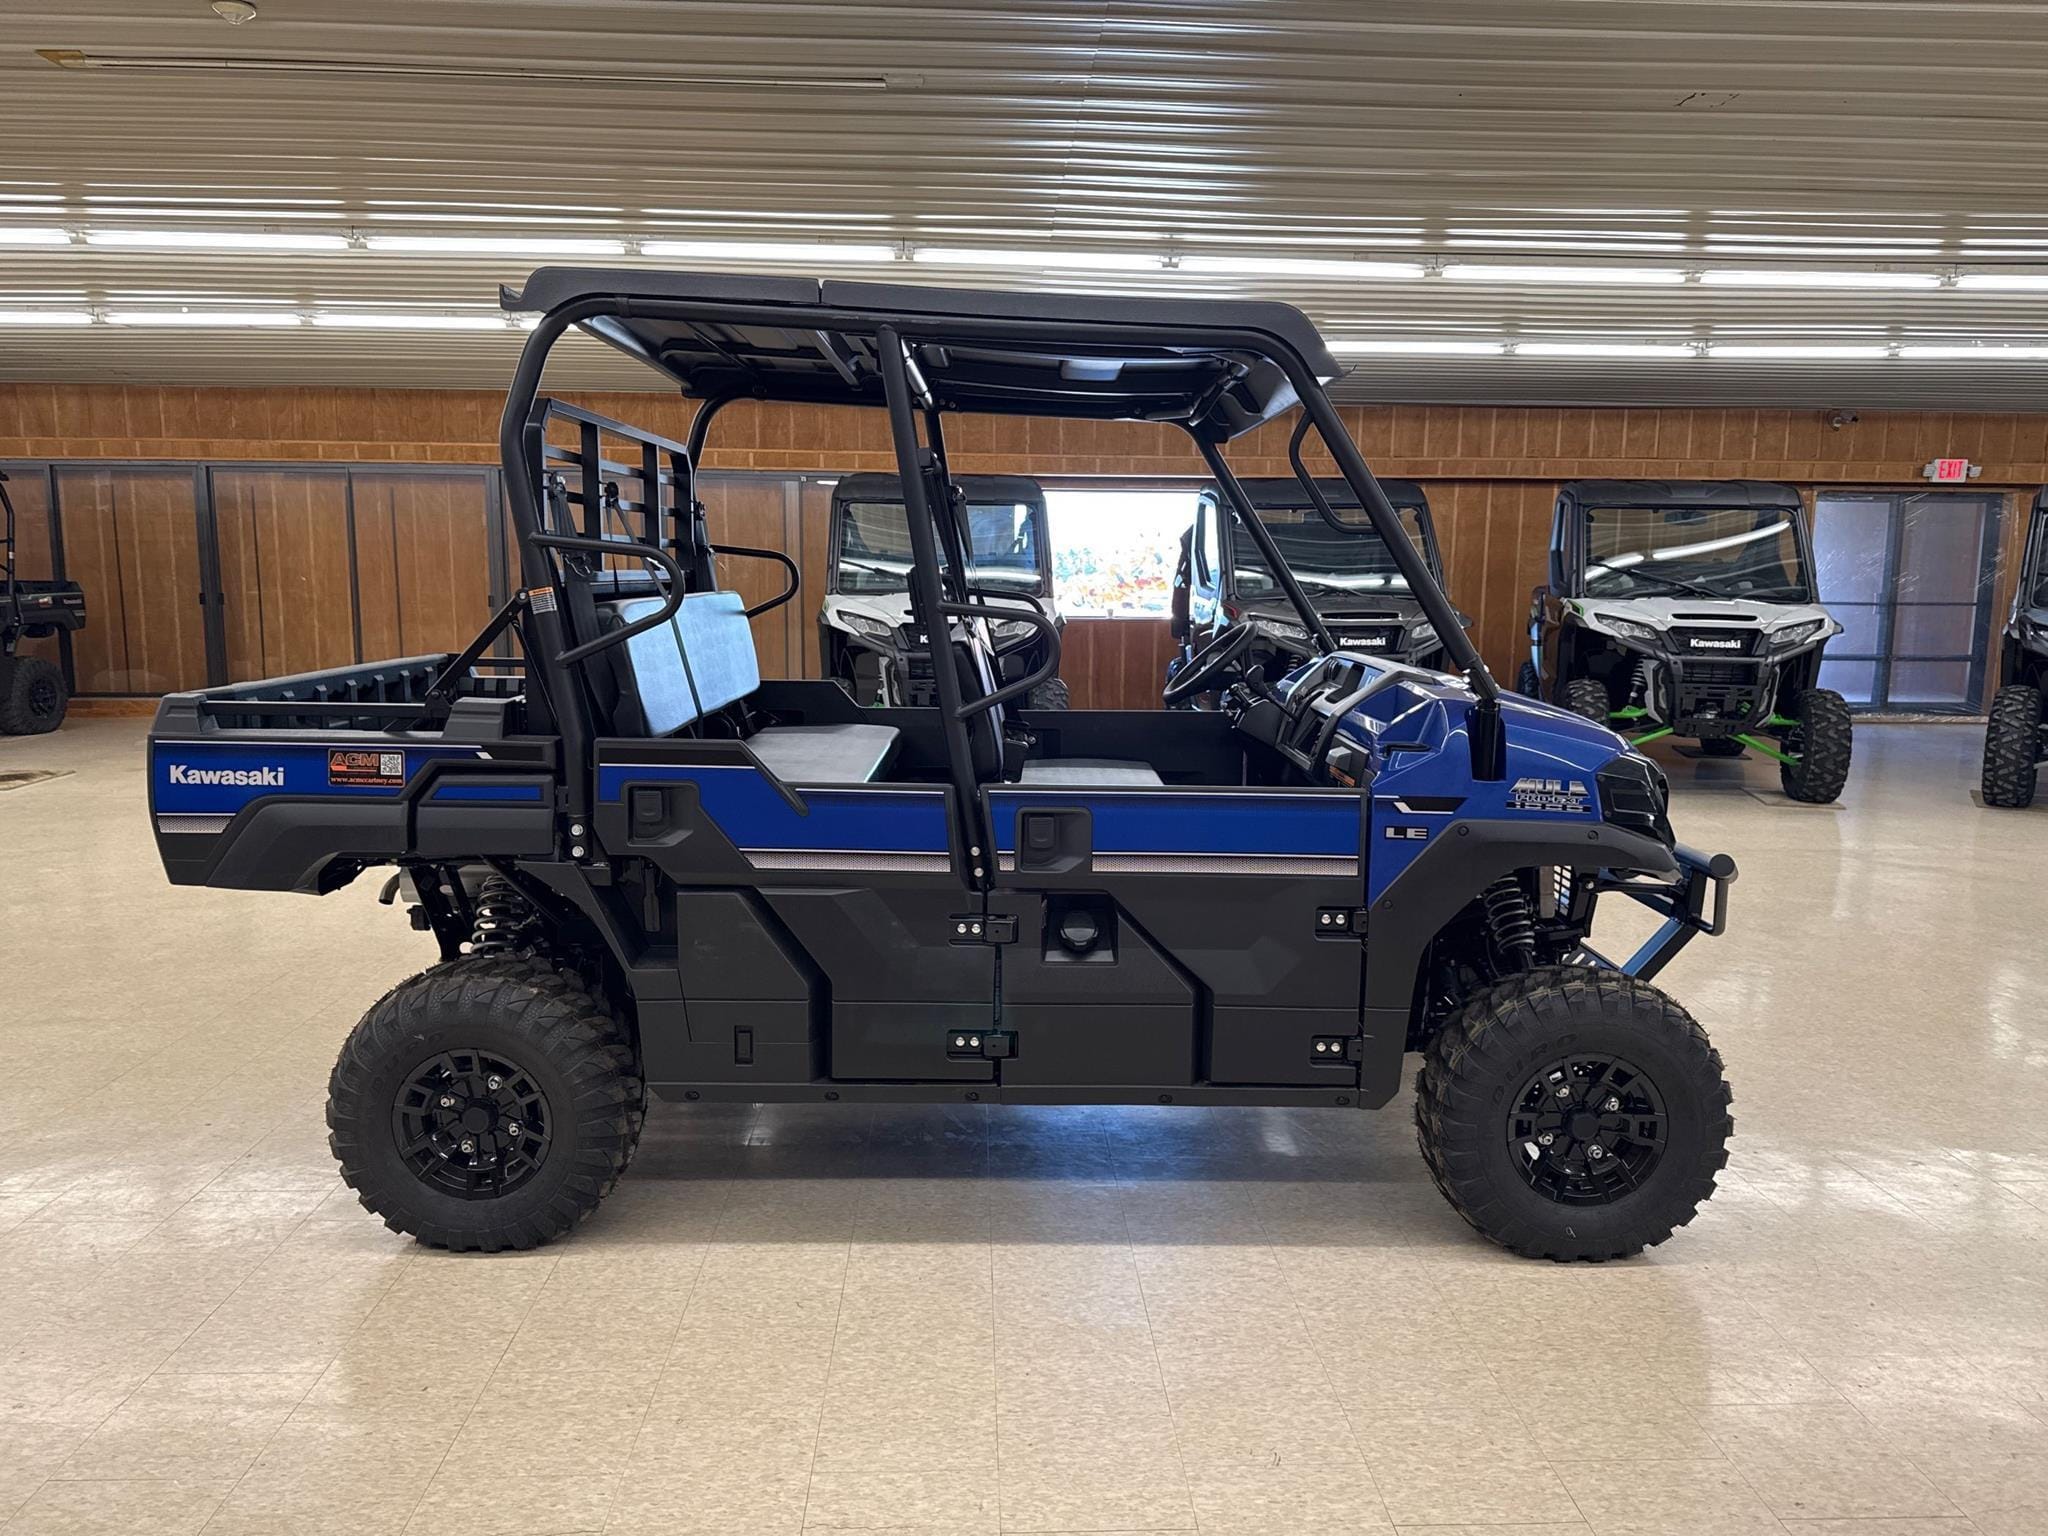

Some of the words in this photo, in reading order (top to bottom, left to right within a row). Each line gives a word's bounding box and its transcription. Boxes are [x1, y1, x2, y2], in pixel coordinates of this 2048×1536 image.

[1938, 460, 1964, 479] EXIT
[1340, 637, 1386, 646] Kawasaki
[1690, 638, 1741, 649] Kawasaki
[330, 752, 379, 766] ACM
[169, 765, 284, 786] Kawasaki
[1508, 777, 1590, 798] MULE
[1385, 827, 1428, 839] LE
